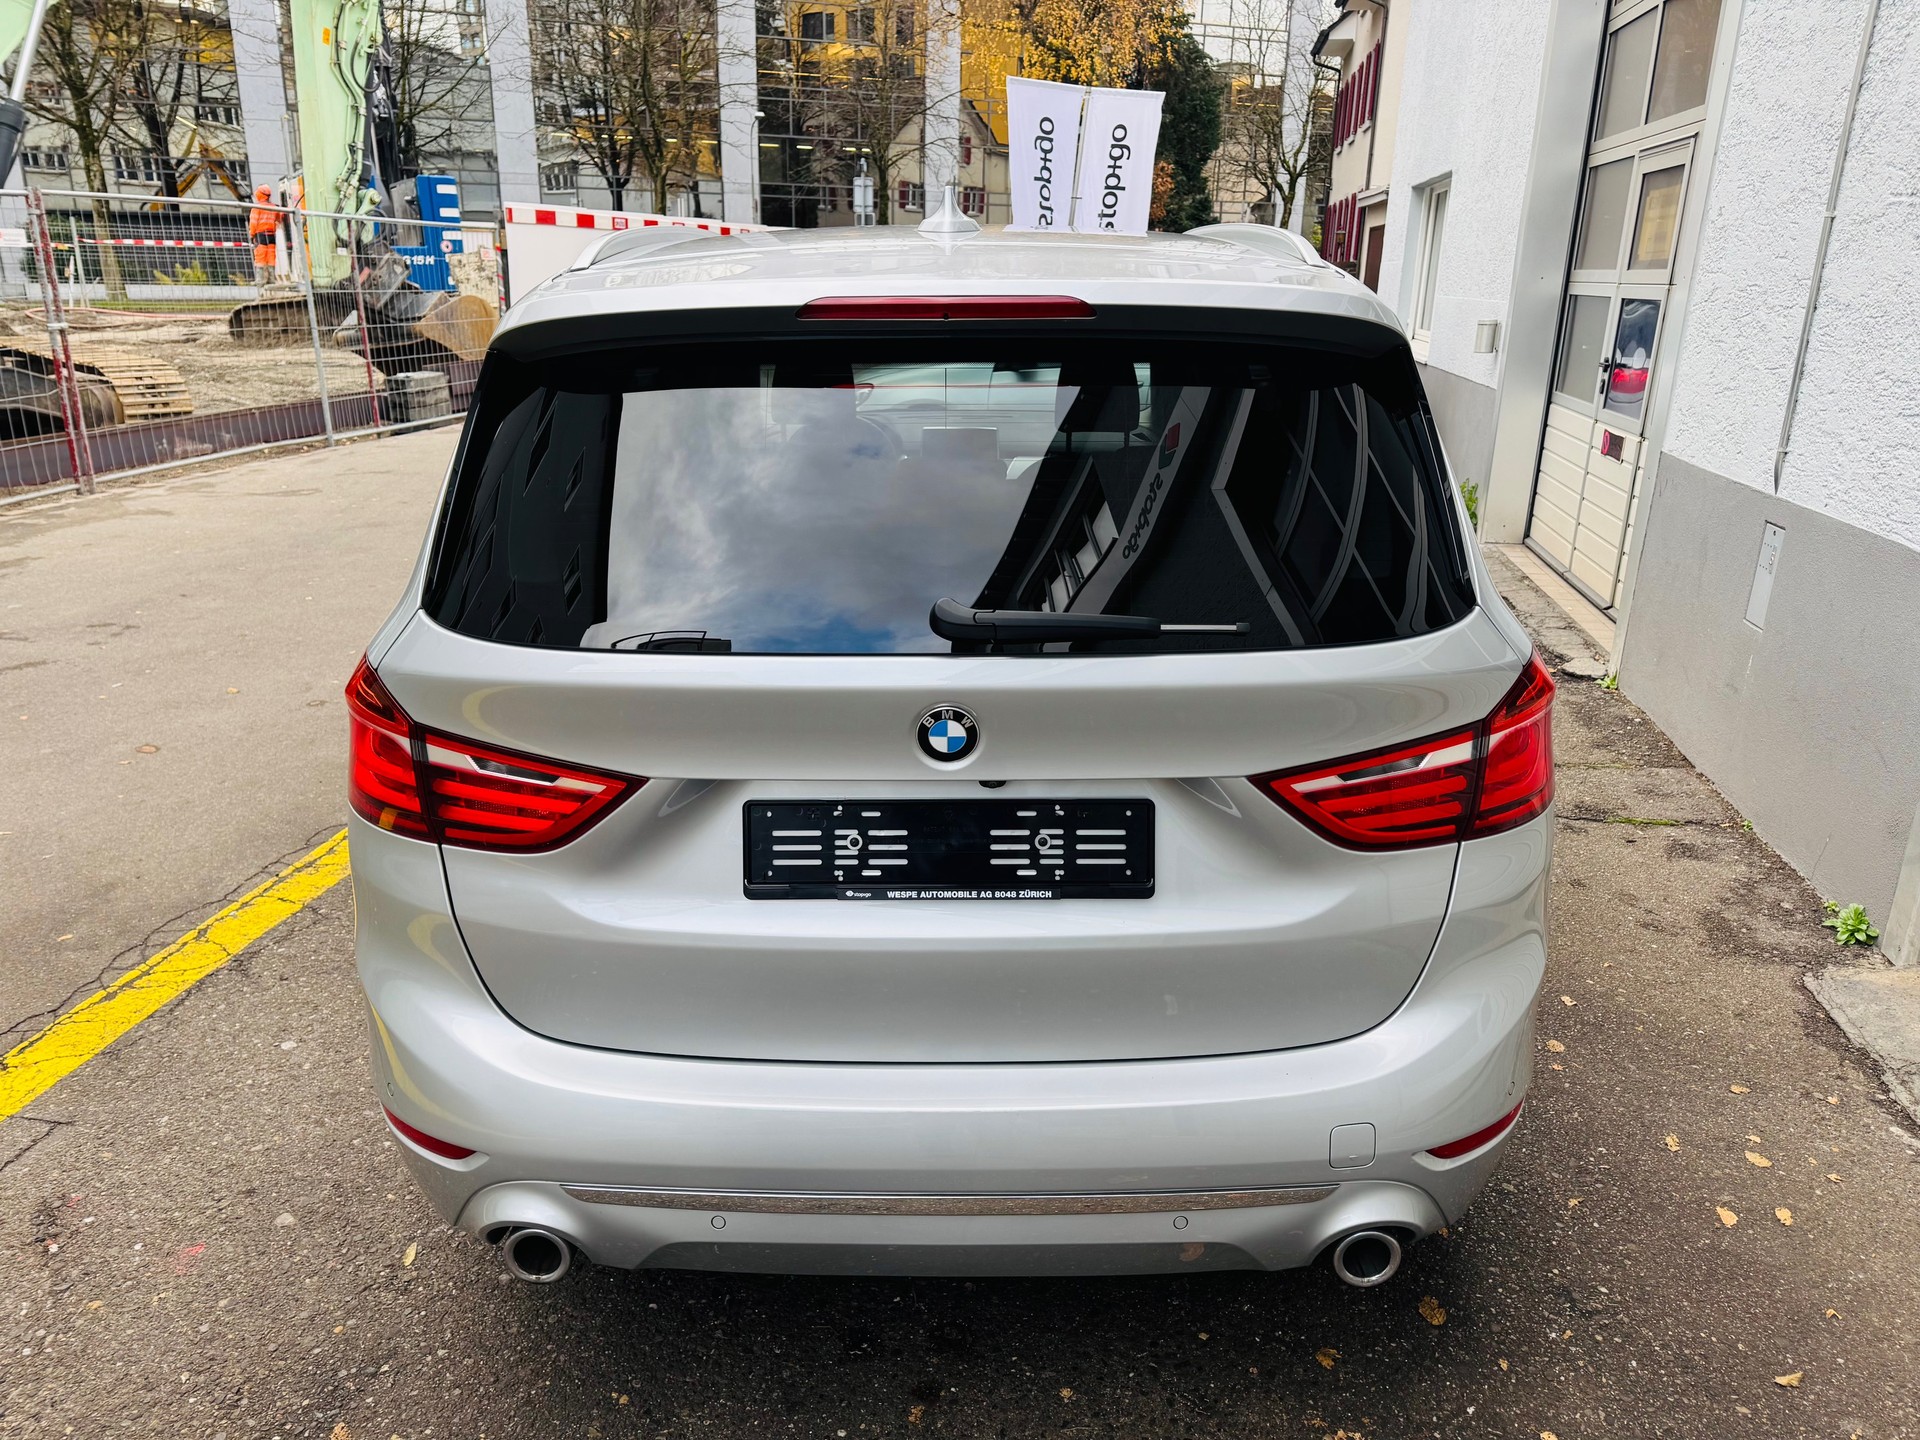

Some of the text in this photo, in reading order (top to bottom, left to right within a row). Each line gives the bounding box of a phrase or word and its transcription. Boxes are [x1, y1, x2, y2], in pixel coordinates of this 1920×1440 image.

[922, 709, 974, 728] BMW
[886, 889, 1052, 899] WESPE AUTOMOBILE AG 8048 ZÜRICH
